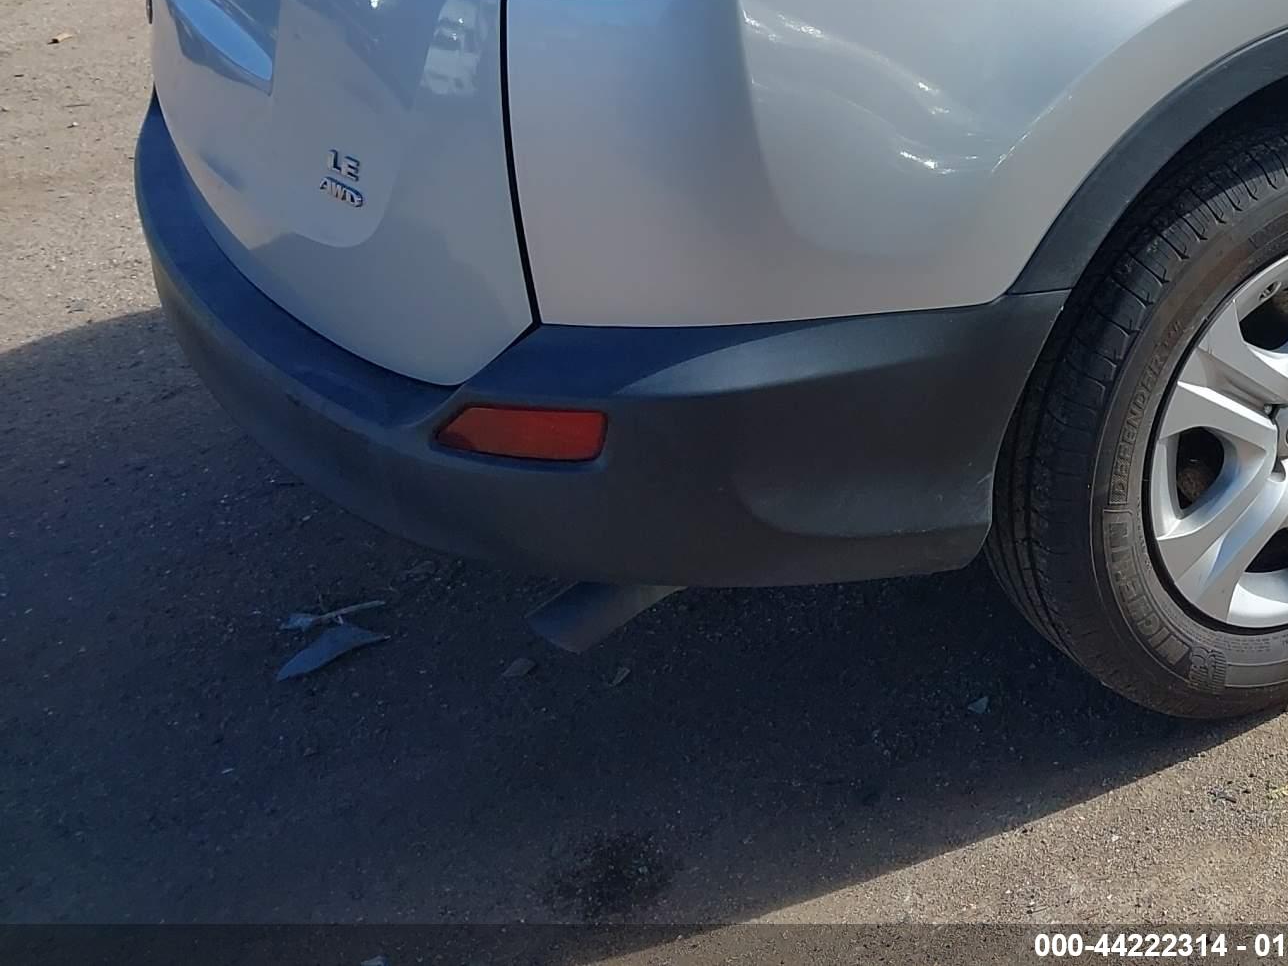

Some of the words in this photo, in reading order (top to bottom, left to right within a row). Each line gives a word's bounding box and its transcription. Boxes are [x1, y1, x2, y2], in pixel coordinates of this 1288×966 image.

[328, 149, 360, 182] LE
[319, 176, 363, 207] AWD
[1108, 521, 1191, 666] MICHELIN
